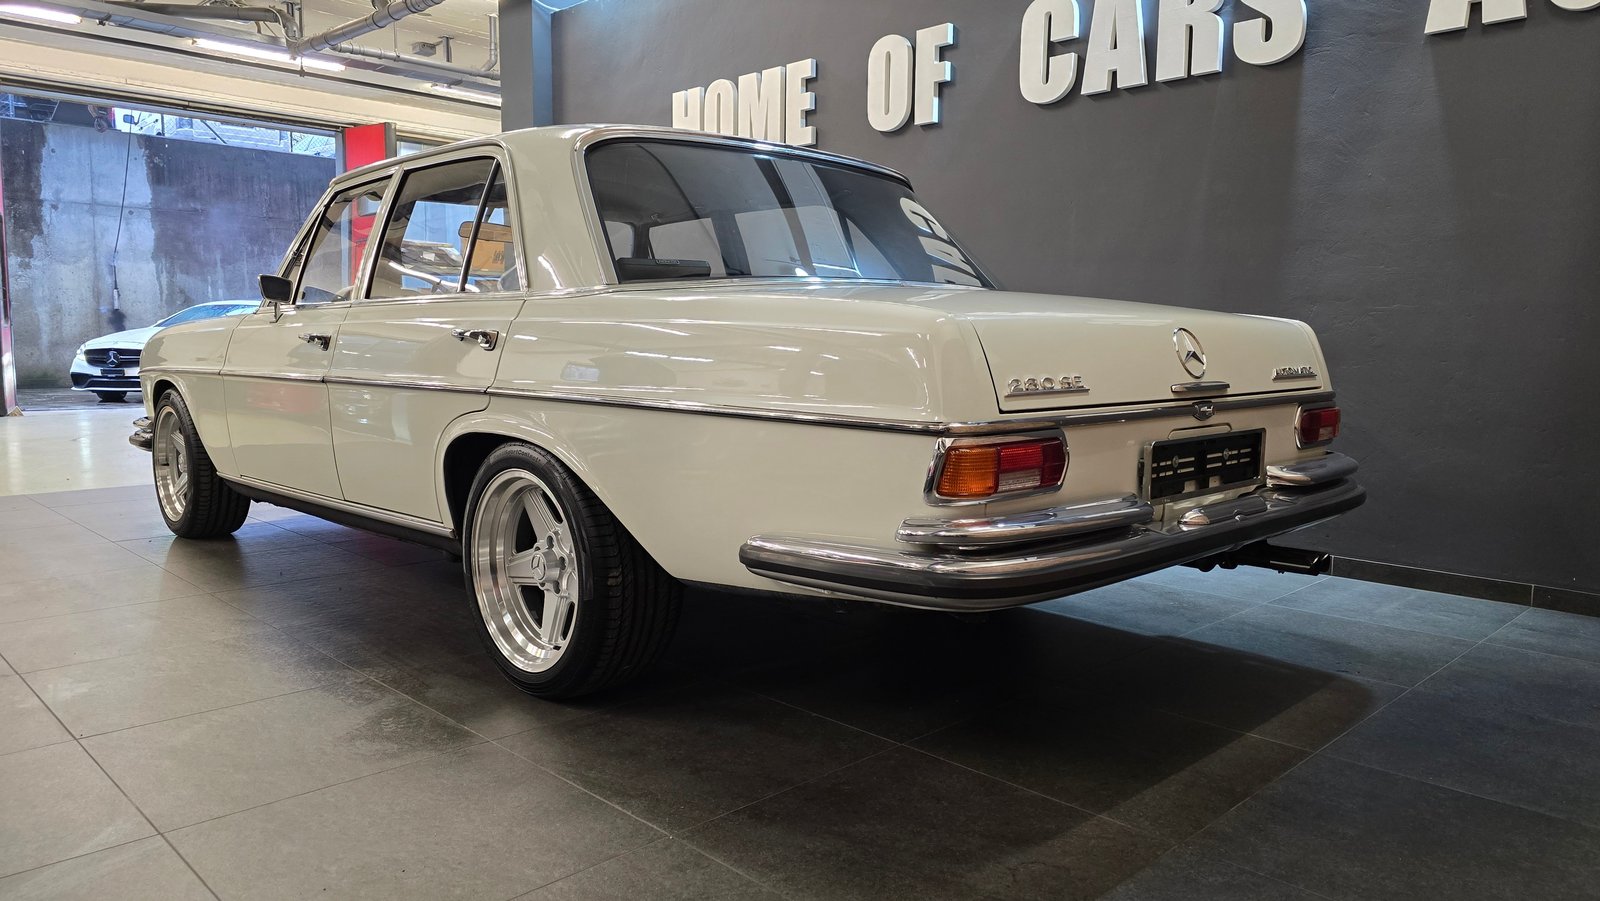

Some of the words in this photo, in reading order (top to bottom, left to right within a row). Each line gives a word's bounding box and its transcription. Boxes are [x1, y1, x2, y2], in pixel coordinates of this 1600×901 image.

[672, 58, 817, 146] HOME
[867, 22, 954, 133] OF
[1008, 376, 1055, 393] 280
[1059, 375, 1085, 390] SE
